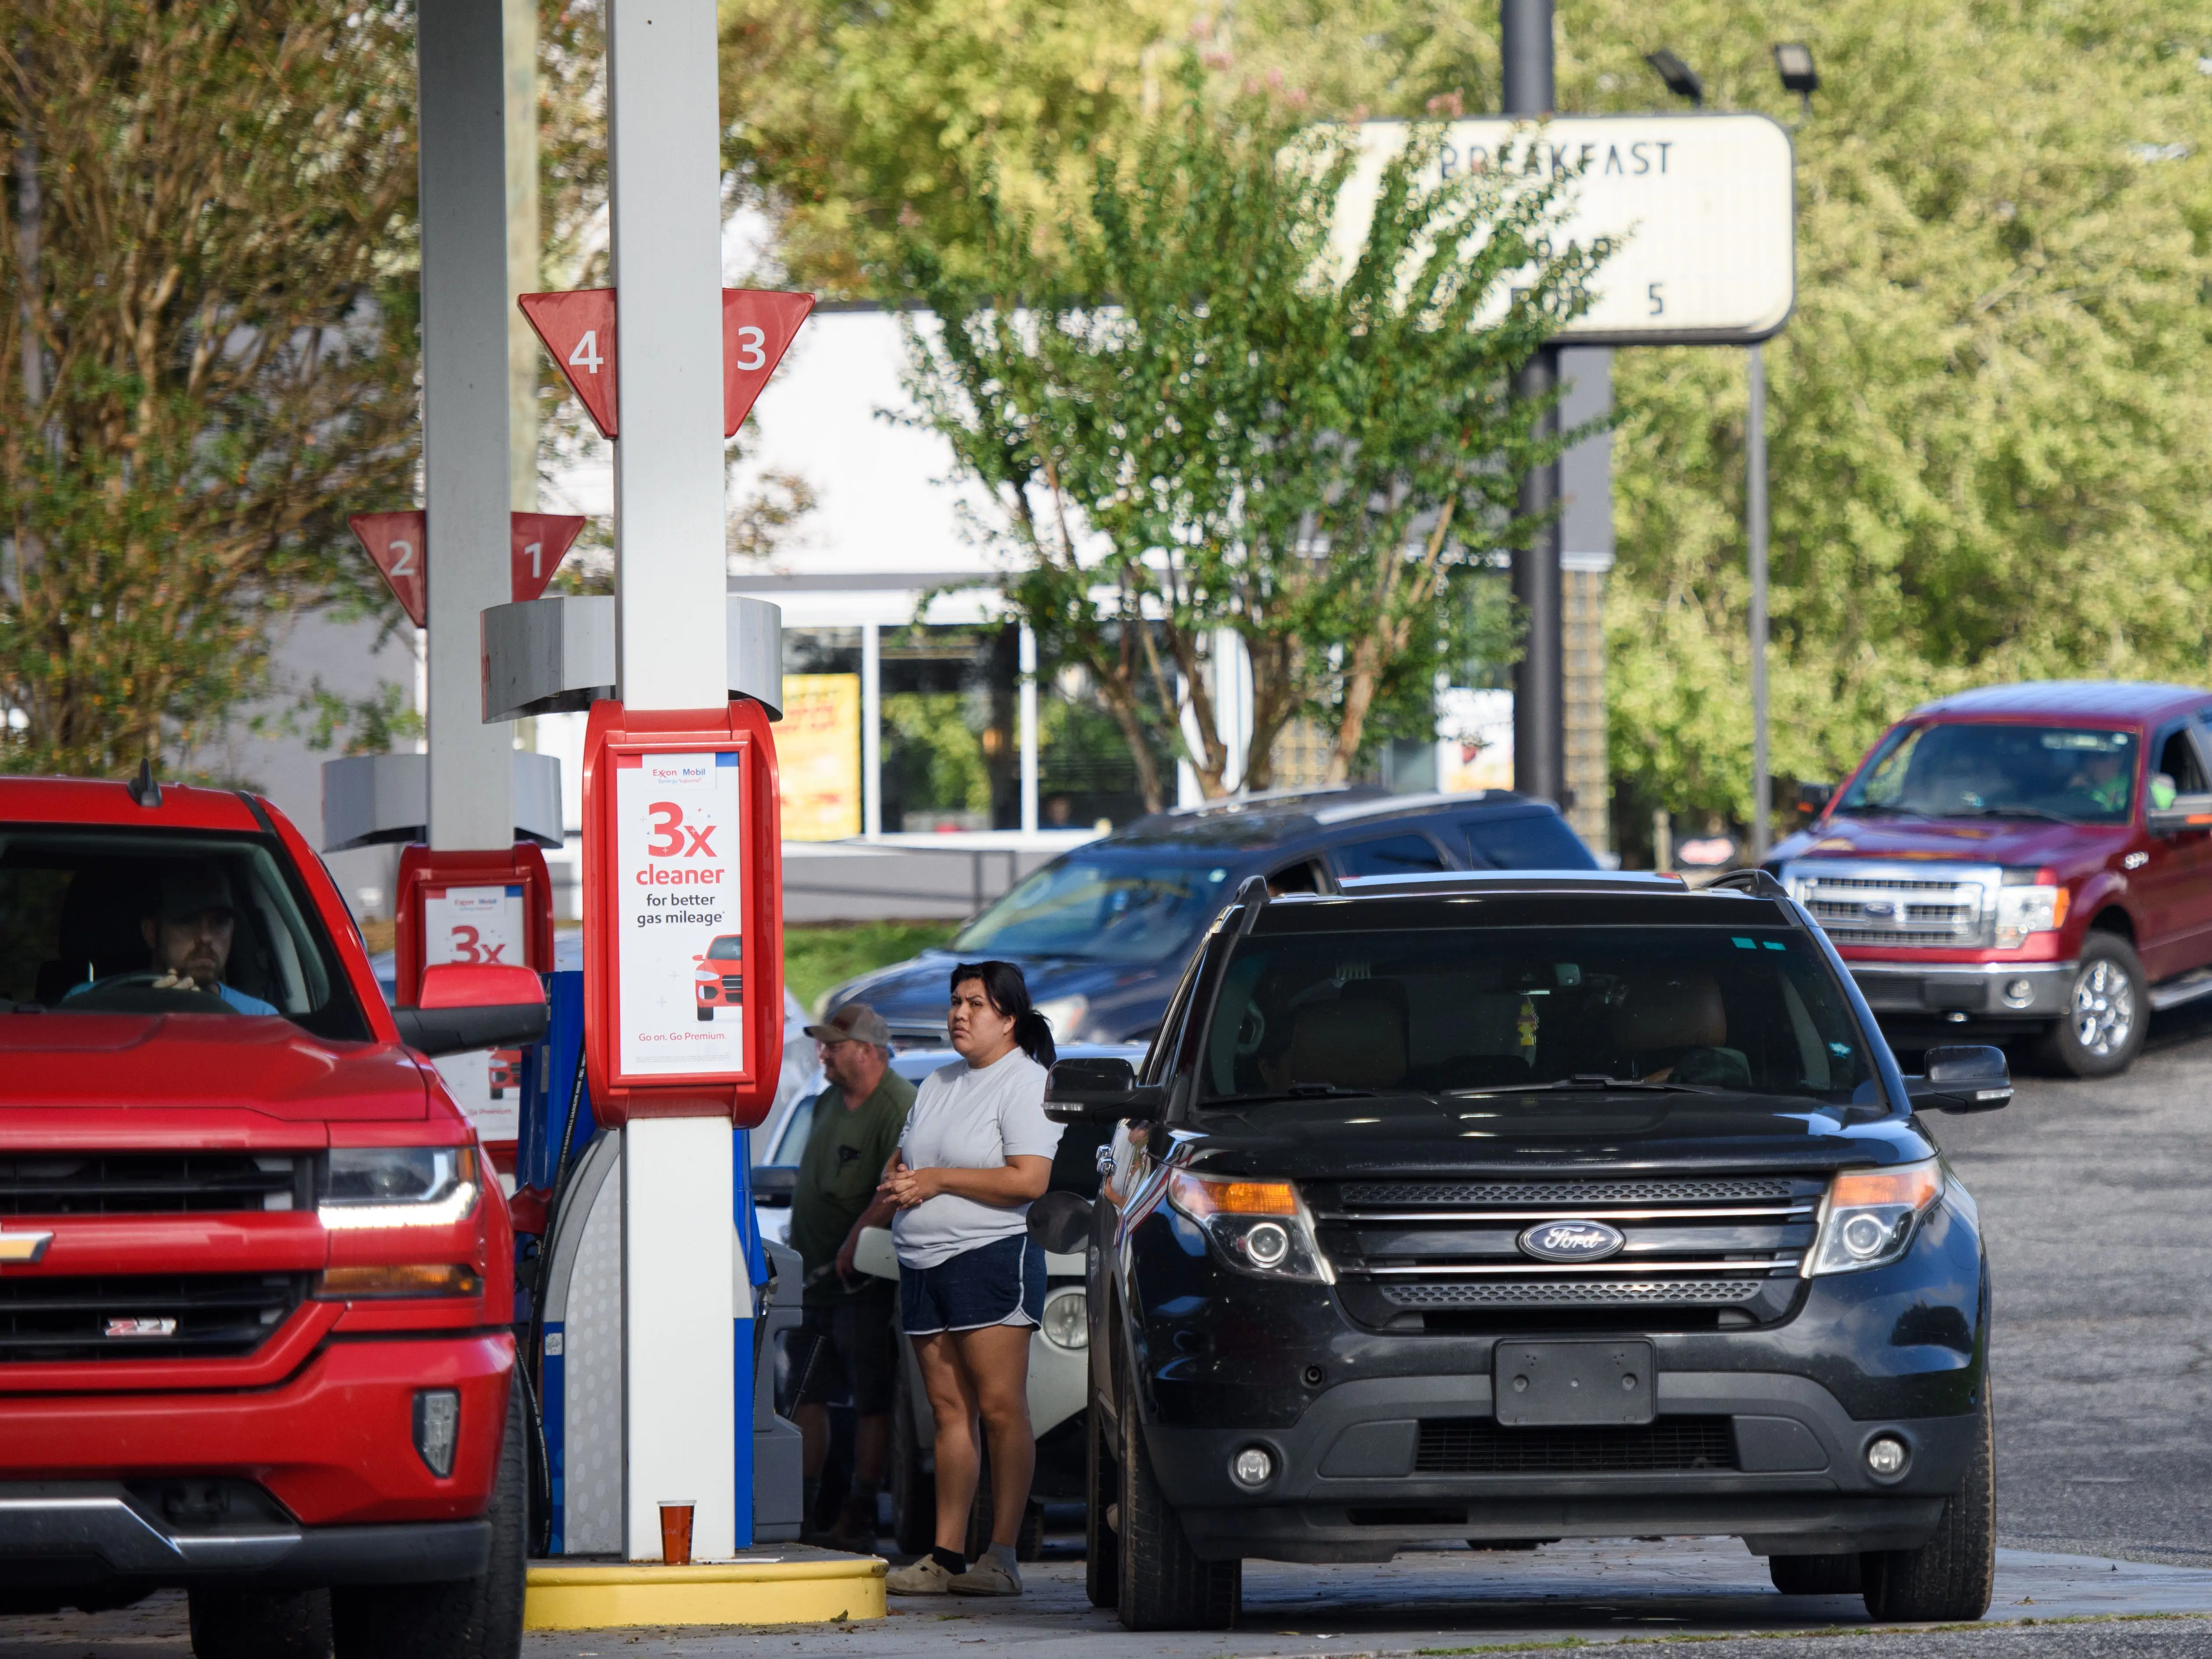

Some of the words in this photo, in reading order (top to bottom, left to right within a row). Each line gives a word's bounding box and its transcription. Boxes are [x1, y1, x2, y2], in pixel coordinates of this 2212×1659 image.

[1440, 141, 1673, 179] BREAKFAST
[1648, 283, 1663, 314] 5
[568, 330, 604, 374] 4
[736, 326, 766, 371] 3
[389, 540, 415, 577] 2
[524, 542, 542, 578] 1
[652, 769, 677, 779] Exxon
[648, 801, 718, 858] 3x
[636, 863, 725, 886] cleaner
[646, 893, 667, 906] for
[671, 893, 715, 906] better
[637, 914, 662, 928] gas
[451, 925, 506, 964] 3x
[639, 1033, 652, 1041] Go
[685, 1031, 727, 1041] Premium.
[1544, 1226, 1605, 1249] Ford
